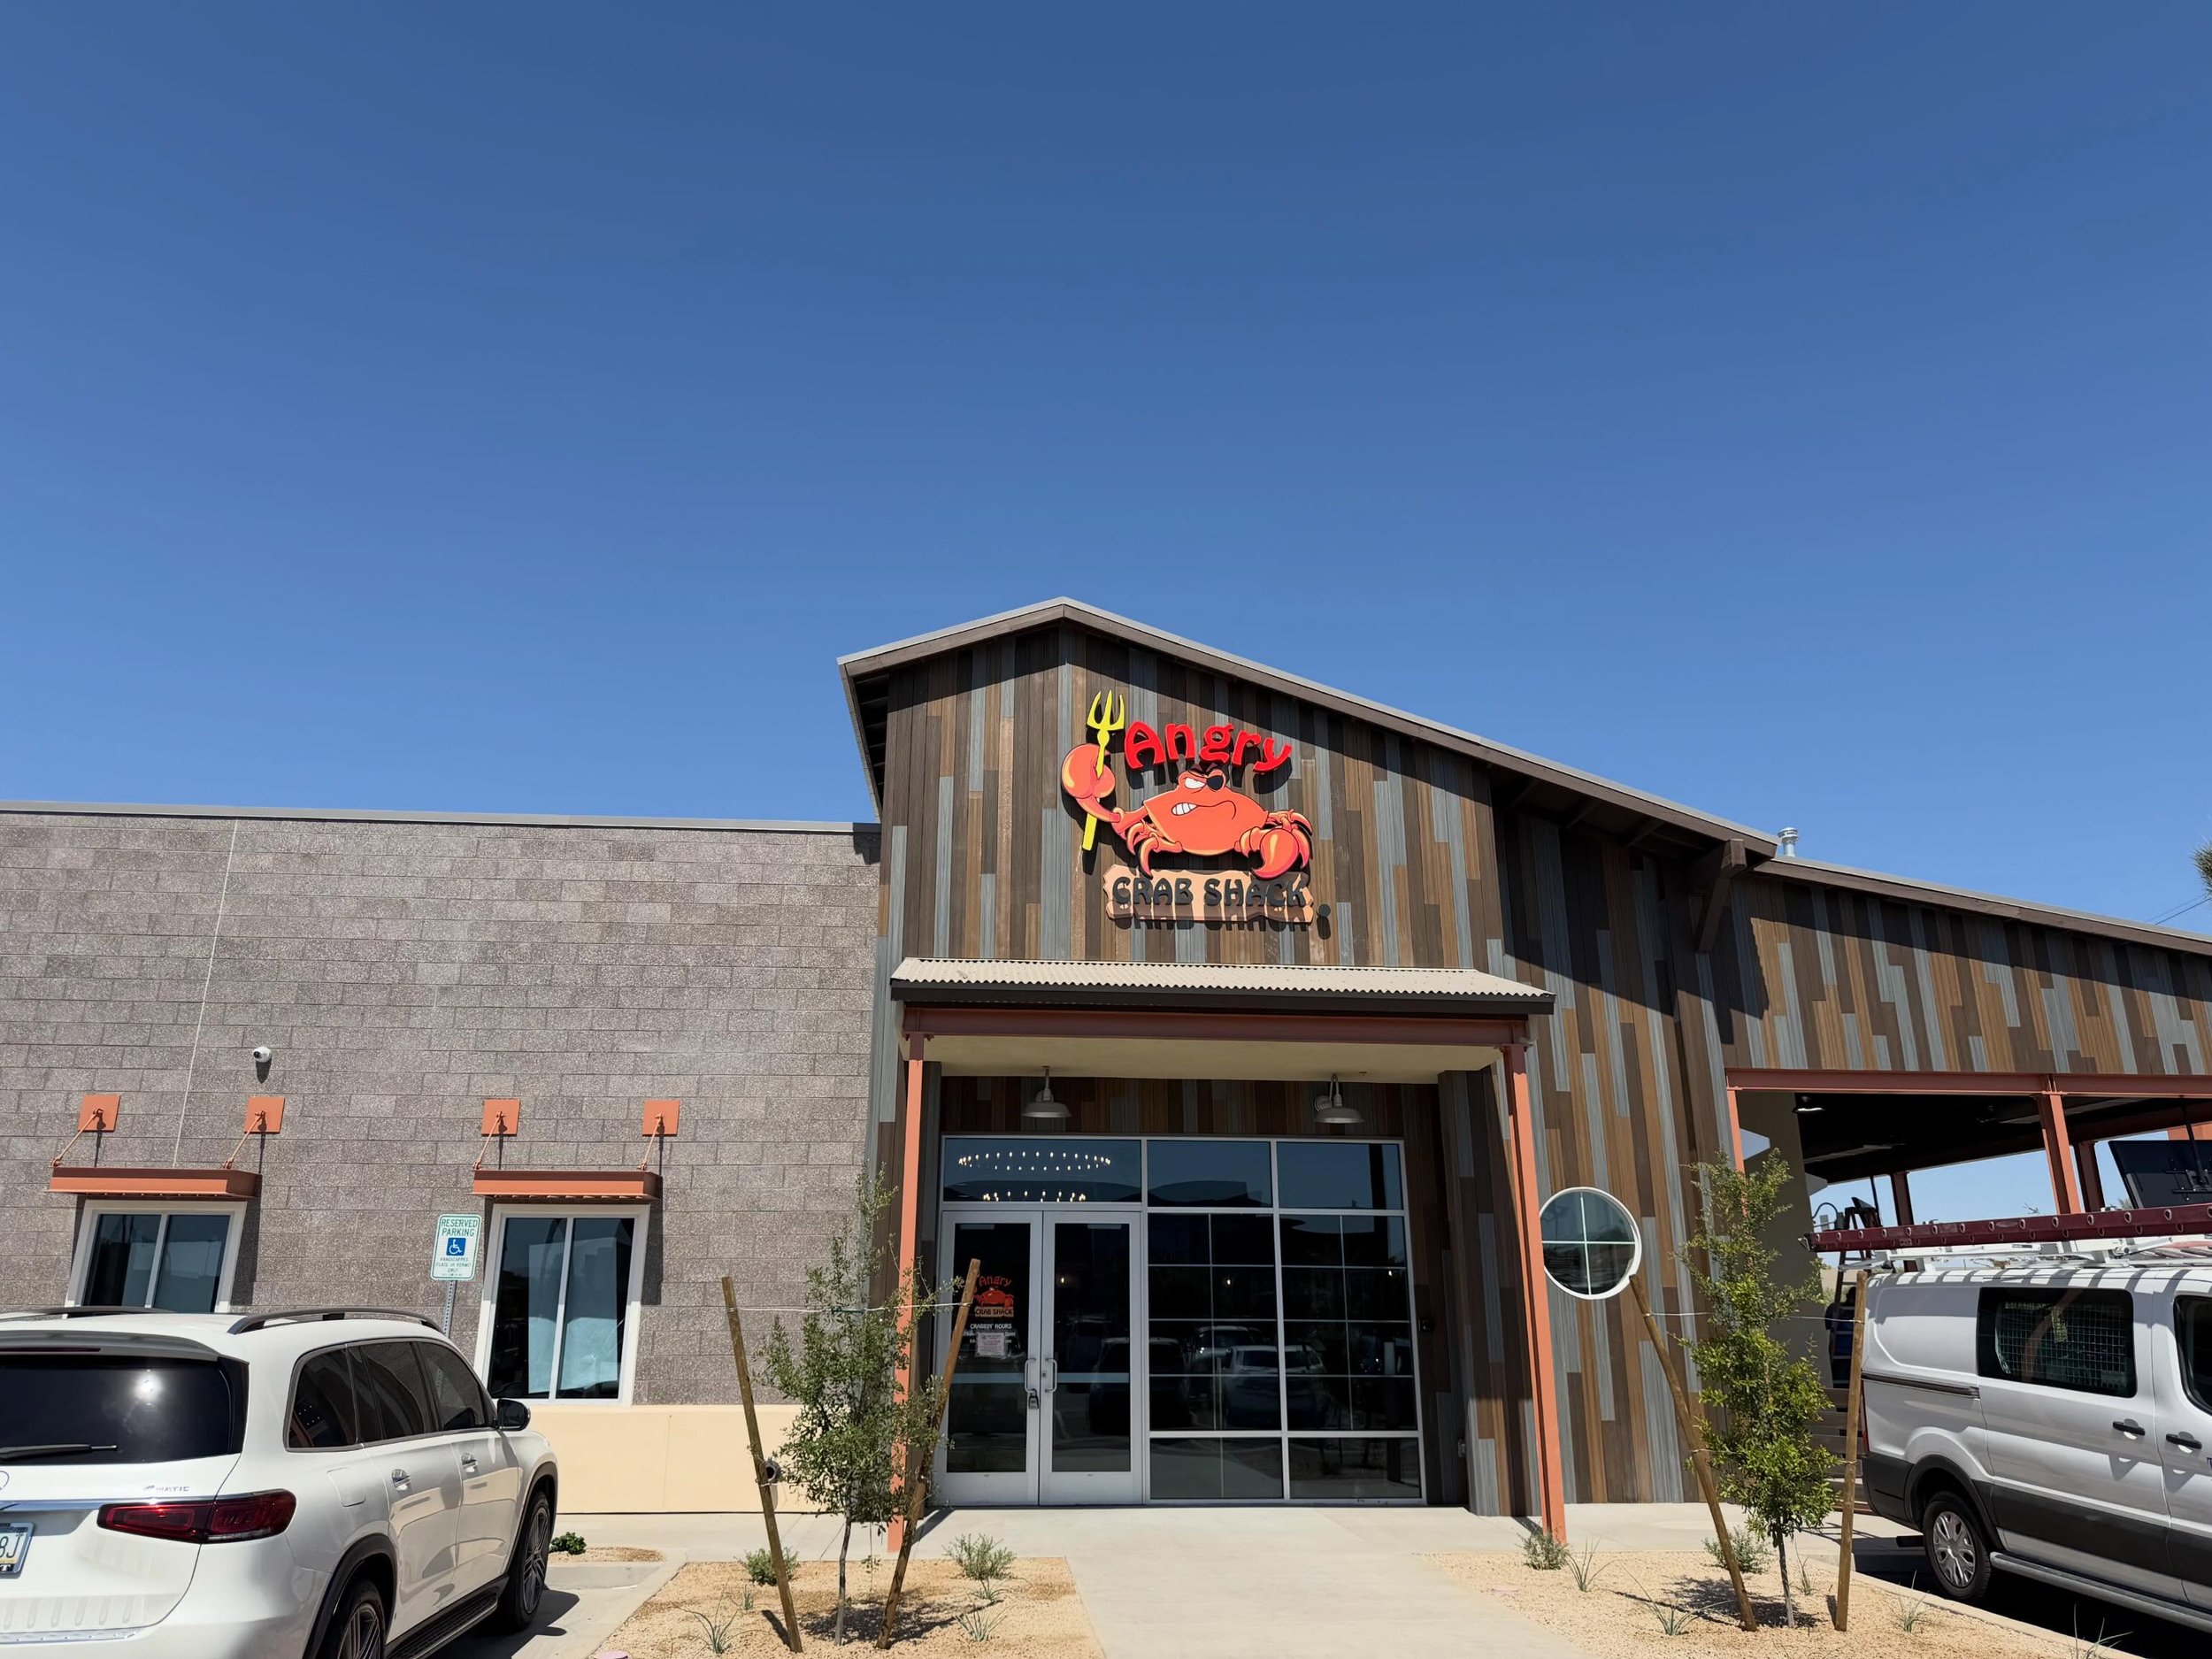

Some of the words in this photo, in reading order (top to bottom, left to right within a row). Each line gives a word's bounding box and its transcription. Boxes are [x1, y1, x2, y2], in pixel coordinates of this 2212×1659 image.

[1125, 720, 1293, 772] Angry
[1112, 876, 1194, 907] CRAB
[1203, 878, 1306, 908] SHACK
[979, 1276, 1011, 1286] Angry
